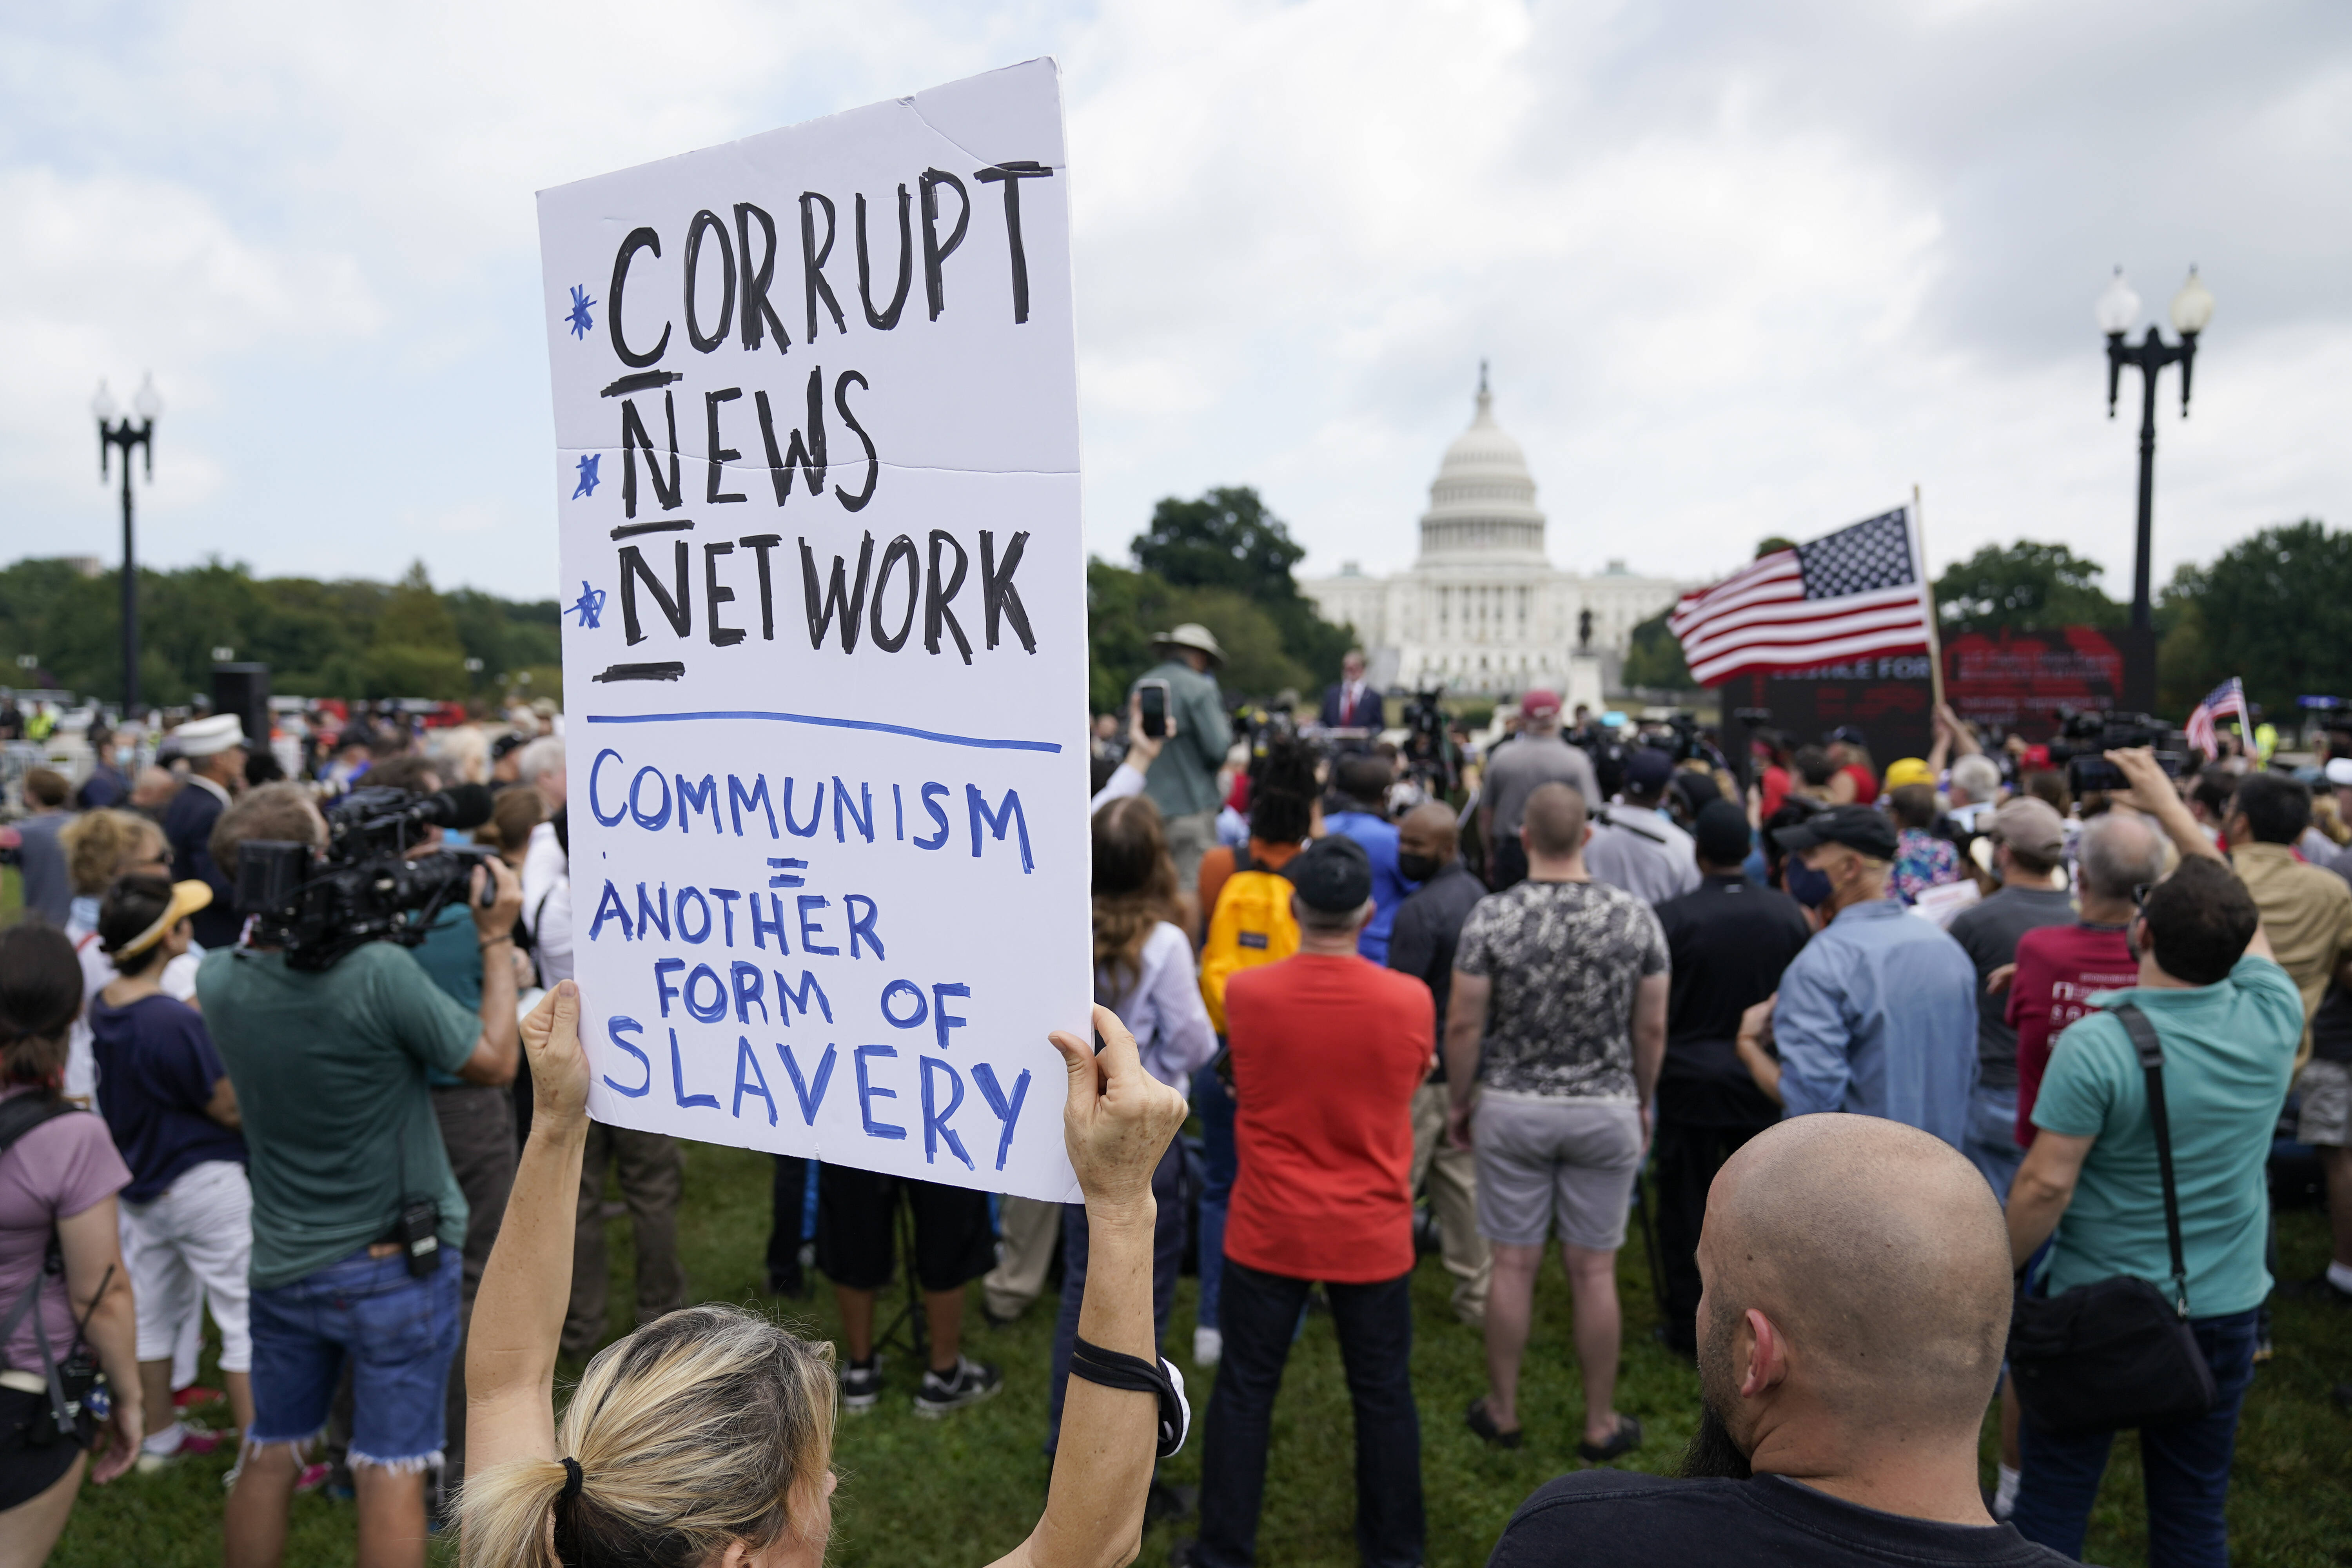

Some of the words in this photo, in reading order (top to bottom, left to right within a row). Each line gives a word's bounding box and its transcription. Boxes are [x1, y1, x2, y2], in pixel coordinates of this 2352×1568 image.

[609, 161, 1054, 368] CORRUPT
[621, 365, 879, 520] NEWS
[618, 529, 1037, 665] NETWORK
[590, 748, 1035, 875] COMMUNISM
[589, 878, 885, 962] ANOTHER
[654, 957, 834, 1028] FORM
[880, 979, 971, 1050] OF
[603, 1015, 1032, 1171] SLAVERY
